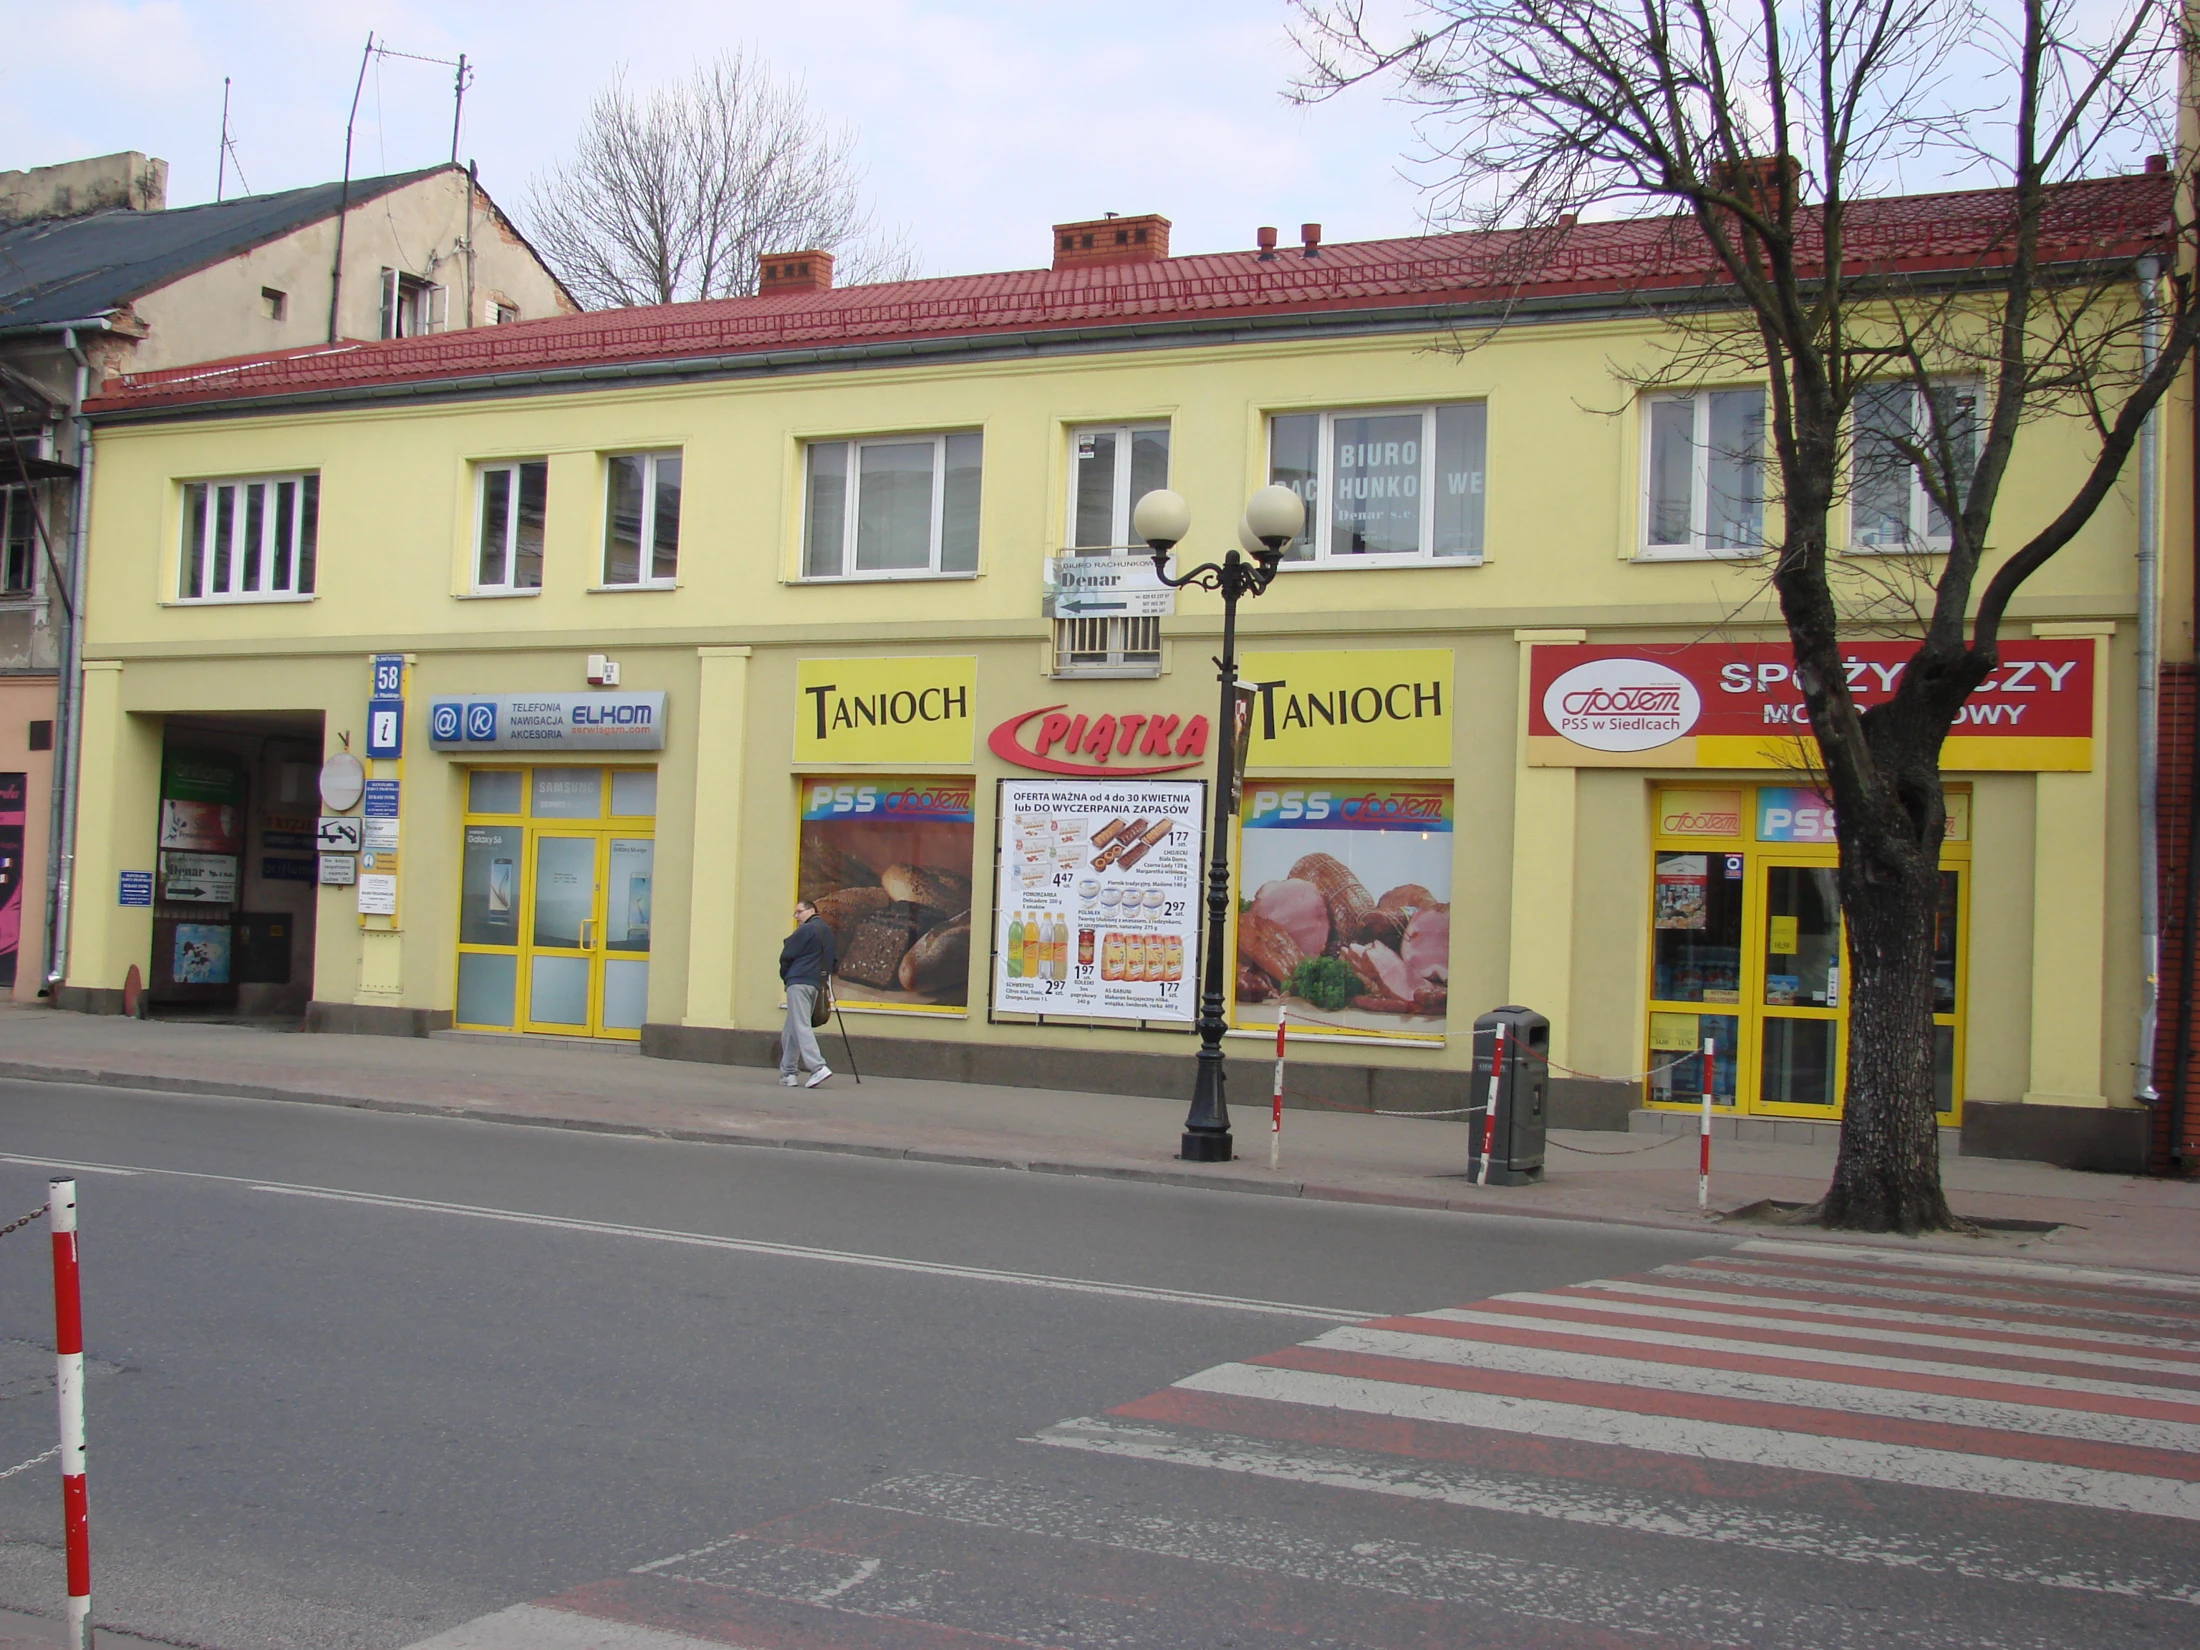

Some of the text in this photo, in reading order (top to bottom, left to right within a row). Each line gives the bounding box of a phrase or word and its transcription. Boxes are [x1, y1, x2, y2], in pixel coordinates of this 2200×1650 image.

[1340, 440, 1417, 468] BIURO
[1339, 474, 1417, 500] HUNKO
[1448, 471, 1483, 495] WE
[1338, 509, 1384, 521] Denar
[1063, 560, 1157, 569] BIURO RACHUNKOW
[1061, 572, 1121, 588] Denar
[378, 666, 399, 690] 58
[1719, 655, 2077, 694] SPŻYCZY
[512, 703, 561, 712] TELEFONIA
[805, 684, 967, 740] TANIOCH
[510, 716, 564, 726] NAWIGACJA
[571, 705, 652, 725] ELKOM
[571, 725, 651, 736] serwisgsm.com
[1562, 716, 1681, 731] PSS w Siedlcach
[510, 730, 563, 739] AKCESORIA
[1034, 712, 1209, 763] PIĄTKA
[539, 781, 595, 795] SAMSUNG
[811, 786, 878, 813] PSS
[1013, 791, 1191, 803] OFERTA WAŻNA od 4 do 30 KWIETNIA
[1014, 803, 1190, 814] lub DO WYCZERPANIA ZAPASÓW
[1252, 791, 1332, 820] PSS
[468, 835, 503, 845] Galaxy S6
[167, 863, 205, 877] Denar
